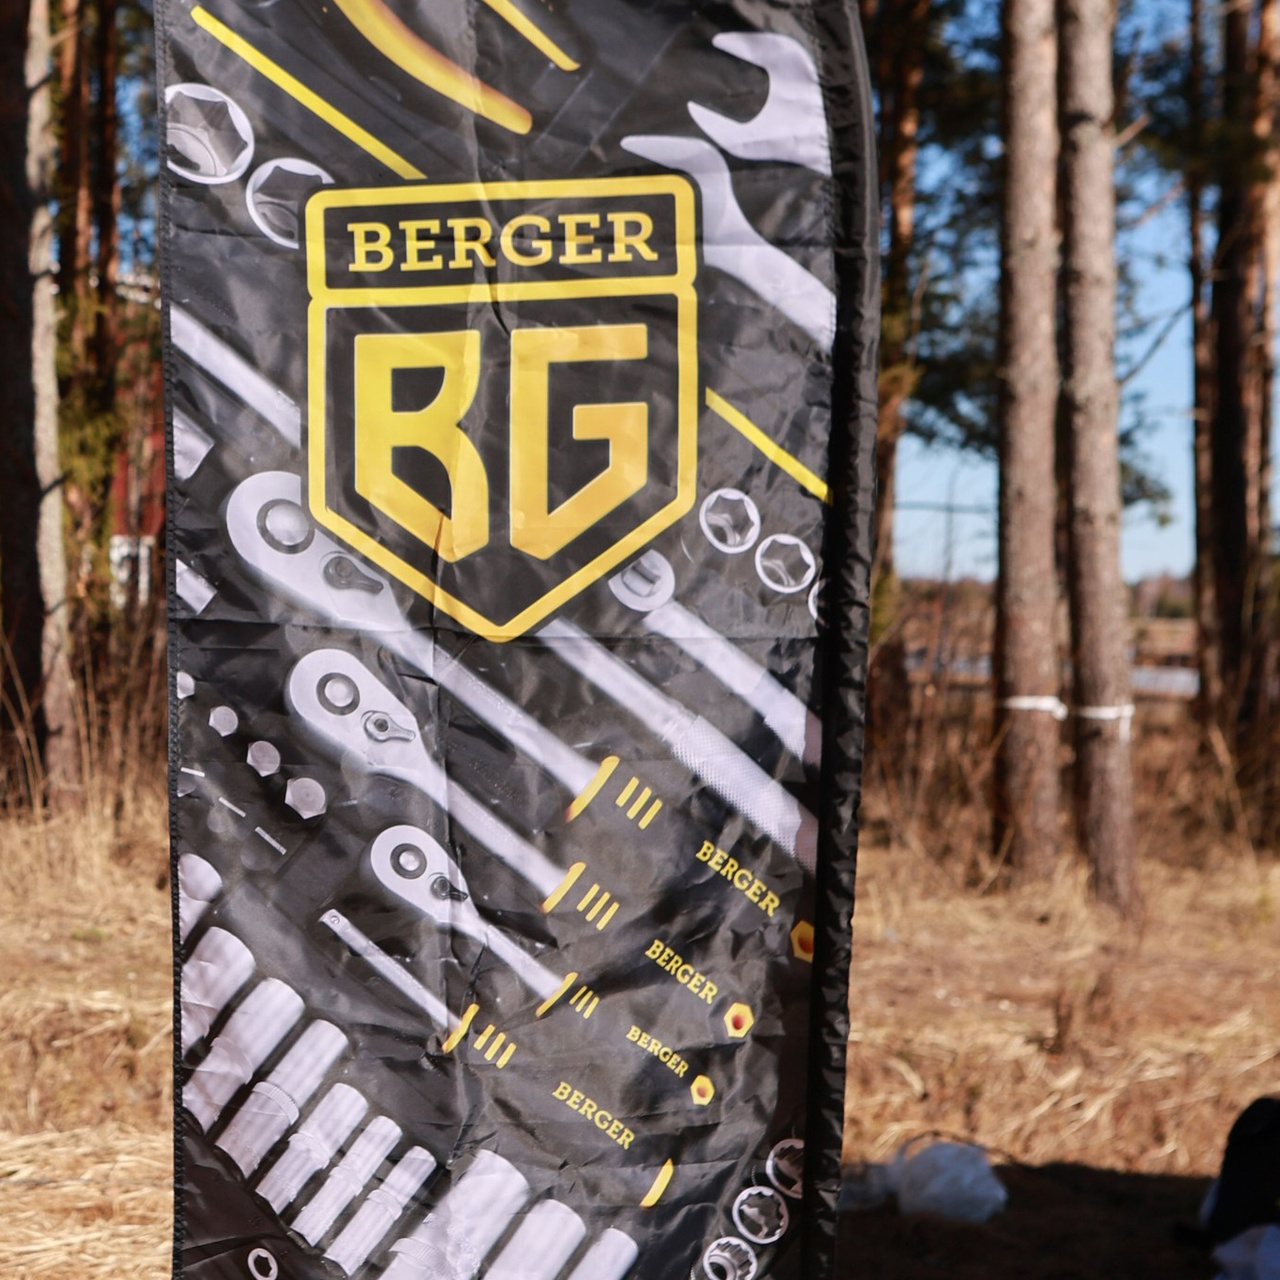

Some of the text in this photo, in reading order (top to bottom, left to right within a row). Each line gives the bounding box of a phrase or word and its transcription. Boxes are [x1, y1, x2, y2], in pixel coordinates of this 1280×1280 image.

[346, 211, 658, 274] BERGER
[354, 323, 649, 564] BG
[695, 840, 781, 918] BERGER
[644, 939, 719, 1006] BERGER
[625, 1025, 689, 1079] BERGER
[551, 1081, 637, 1151] BERGER
